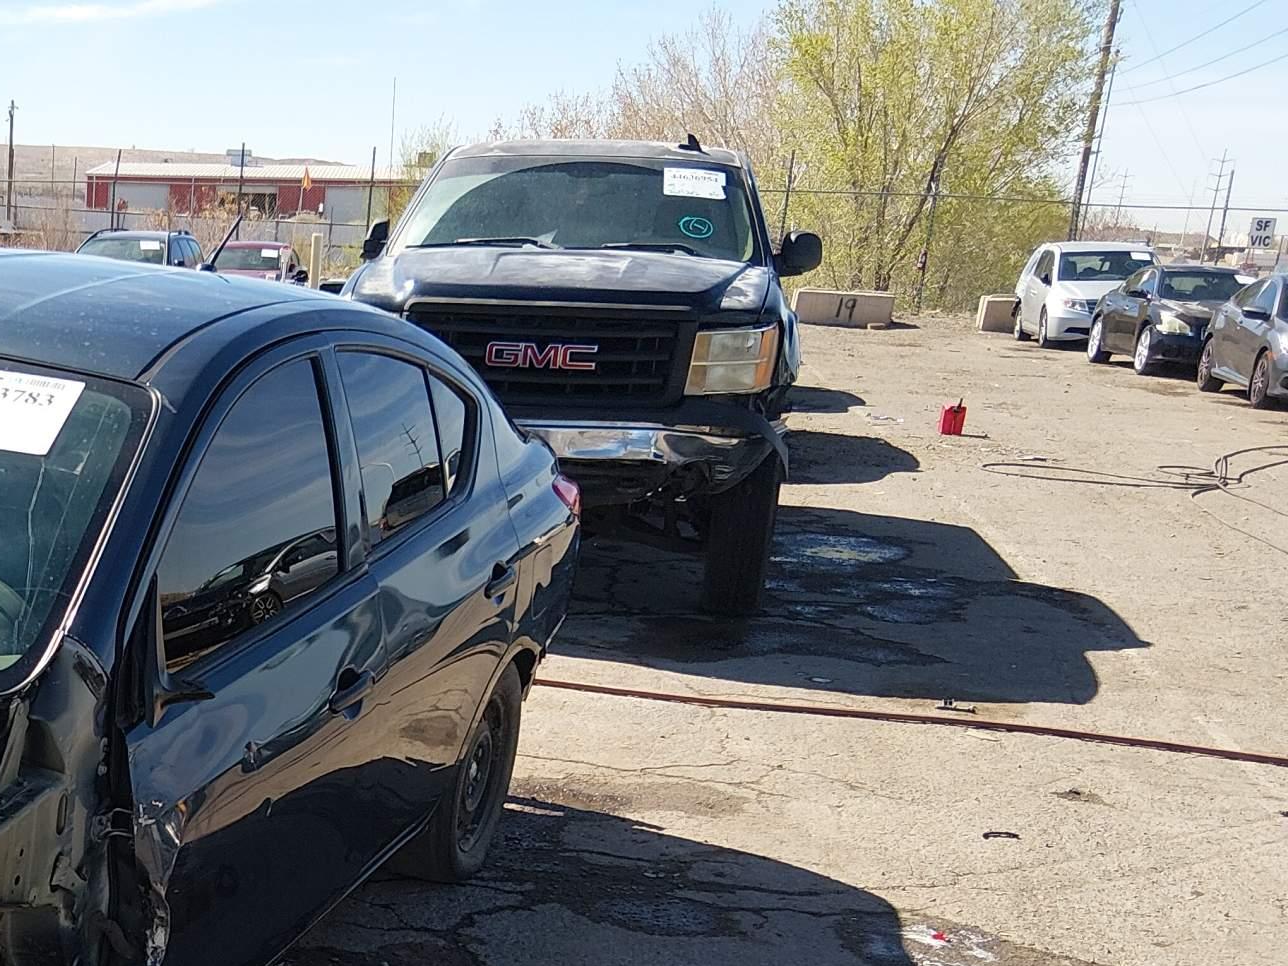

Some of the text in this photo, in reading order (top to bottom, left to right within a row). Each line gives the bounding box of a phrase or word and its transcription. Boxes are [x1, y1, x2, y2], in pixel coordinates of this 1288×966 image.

[1255, 220, 1272, 231] SF
[1250, 235, 1271, 247] VIC
[835, 297, 858, 320] 19
[485, 341, 598, 370] GMC
